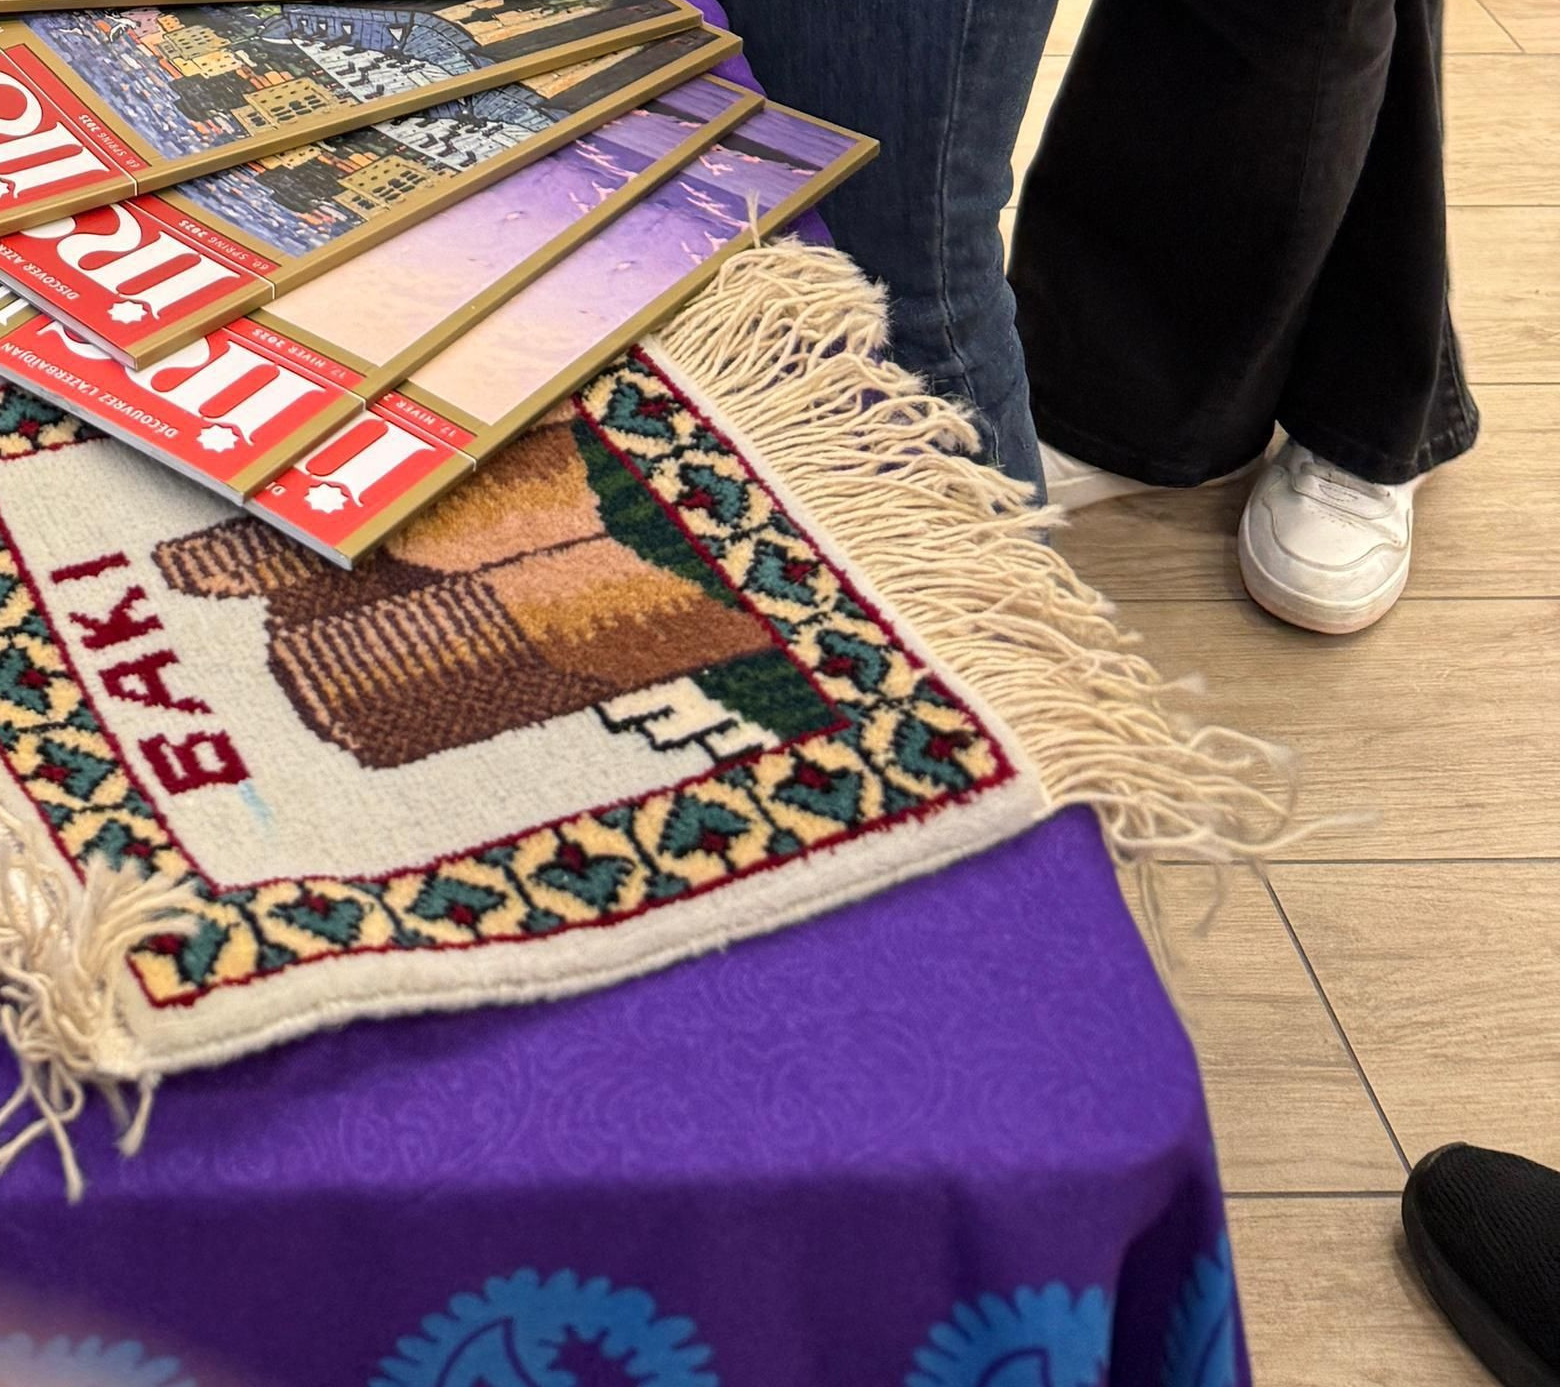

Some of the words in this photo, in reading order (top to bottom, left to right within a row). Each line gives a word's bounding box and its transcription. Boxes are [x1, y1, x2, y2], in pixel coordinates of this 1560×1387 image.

[78, 113, 100, 135] 2025
[96, 130, 128, 158] SPRING
[177, 218, 207, 238] 2025
[206, 236, 250, 263] SPRING
[23, 260, 82, 301] DISCOVER
[250, 326, 286, 350] 2025
[287, 344, 328, 370] HIVER
[97, 393, 180, 440] DÉCOUVREZ
[395, 399, 437, 427] HIVER
[51, 551, 252, 795] BAKI
